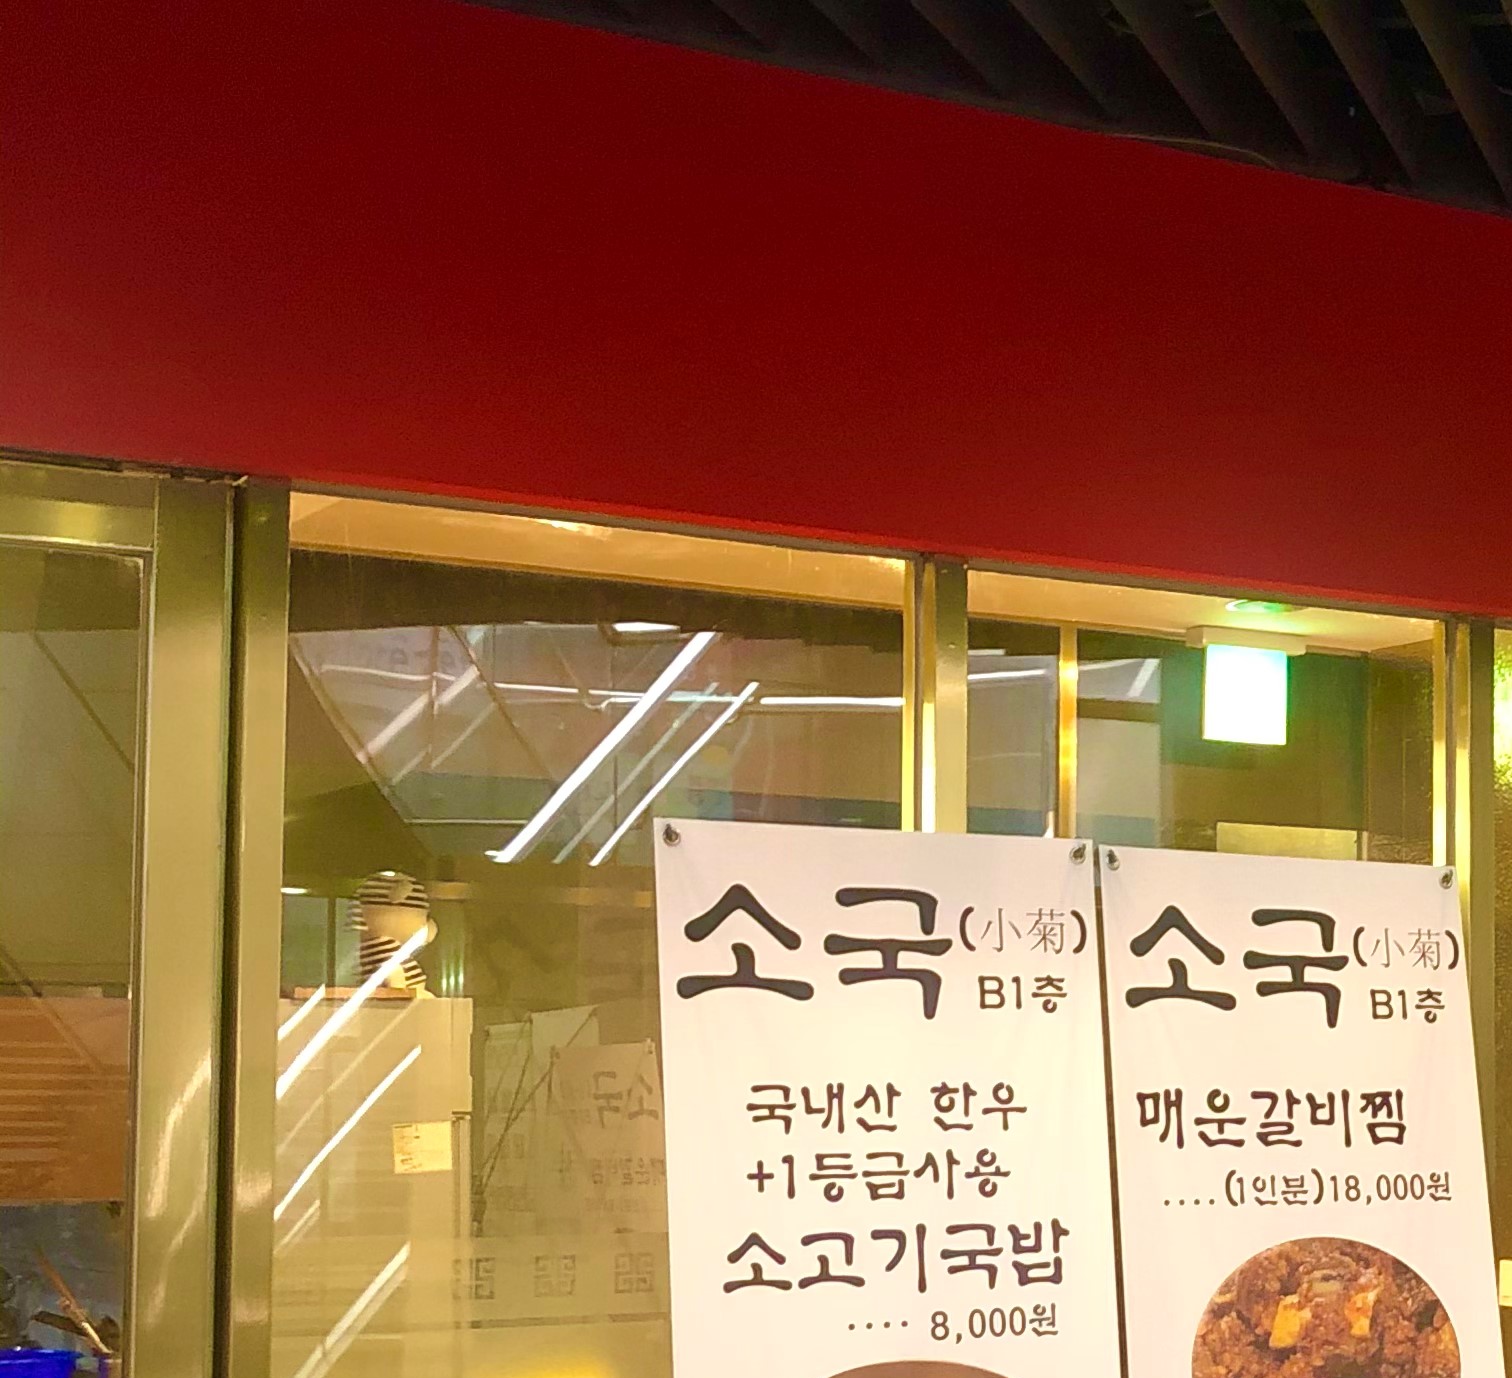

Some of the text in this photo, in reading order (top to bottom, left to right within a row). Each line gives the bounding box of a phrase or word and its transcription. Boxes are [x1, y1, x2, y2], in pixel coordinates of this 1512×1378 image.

[978, 975, 1067, 1013] B1층
[1370, 988, 1445, 1024] B1층
[746, 1082, 1027, 1135] 국내산 한우
[1136, 1088, 1406, 1149] 매운갈비찜
[747, 1148, 1011, 1202] +1등급사용
[723, 1218, 1070, 1293] 소고기국밥
